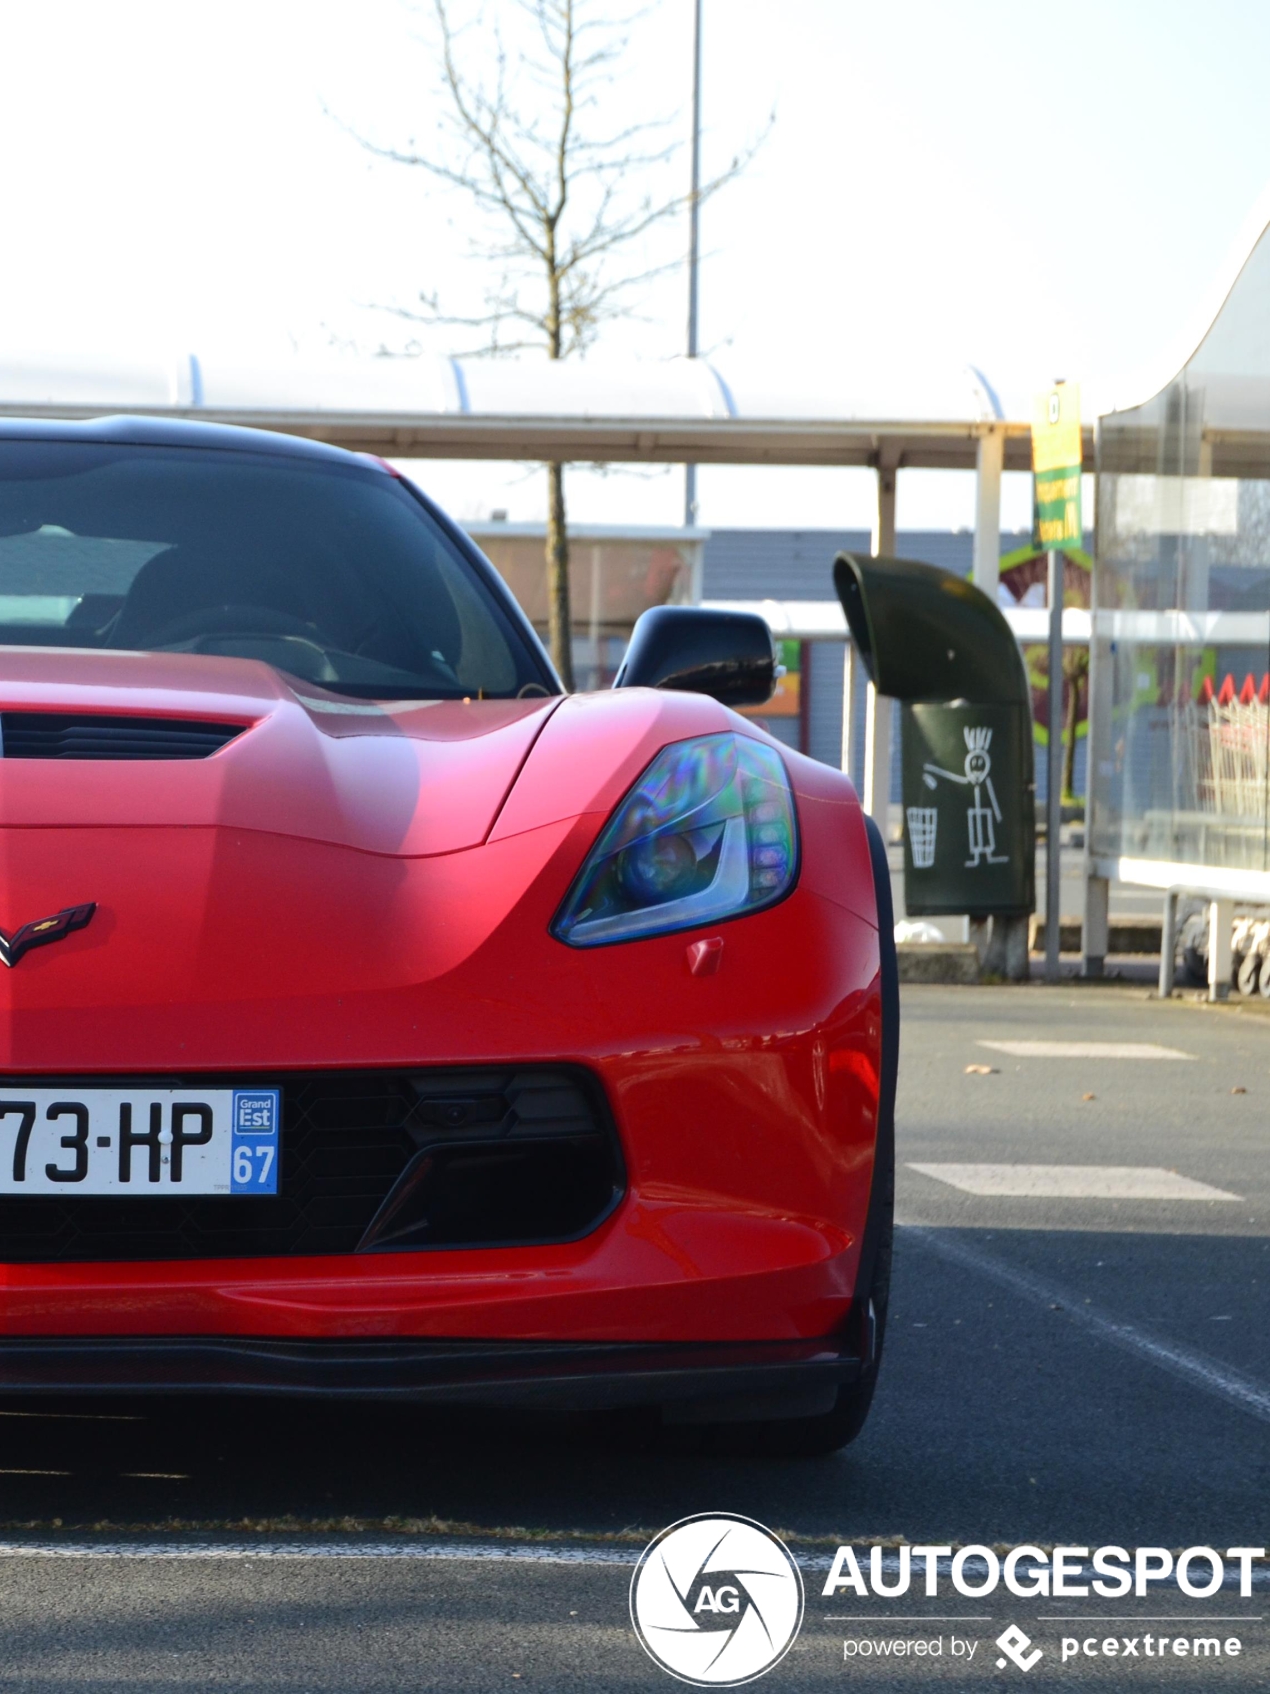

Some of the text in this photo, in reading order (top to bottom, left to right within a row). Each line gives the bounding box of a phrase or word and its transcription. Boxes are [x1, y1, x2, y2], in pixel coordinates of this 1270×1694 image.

[240, 1099, 271, 1109] Grand
[239, 1108, 270, 1126] Est
[233, 1145, 275, 1184] 67
